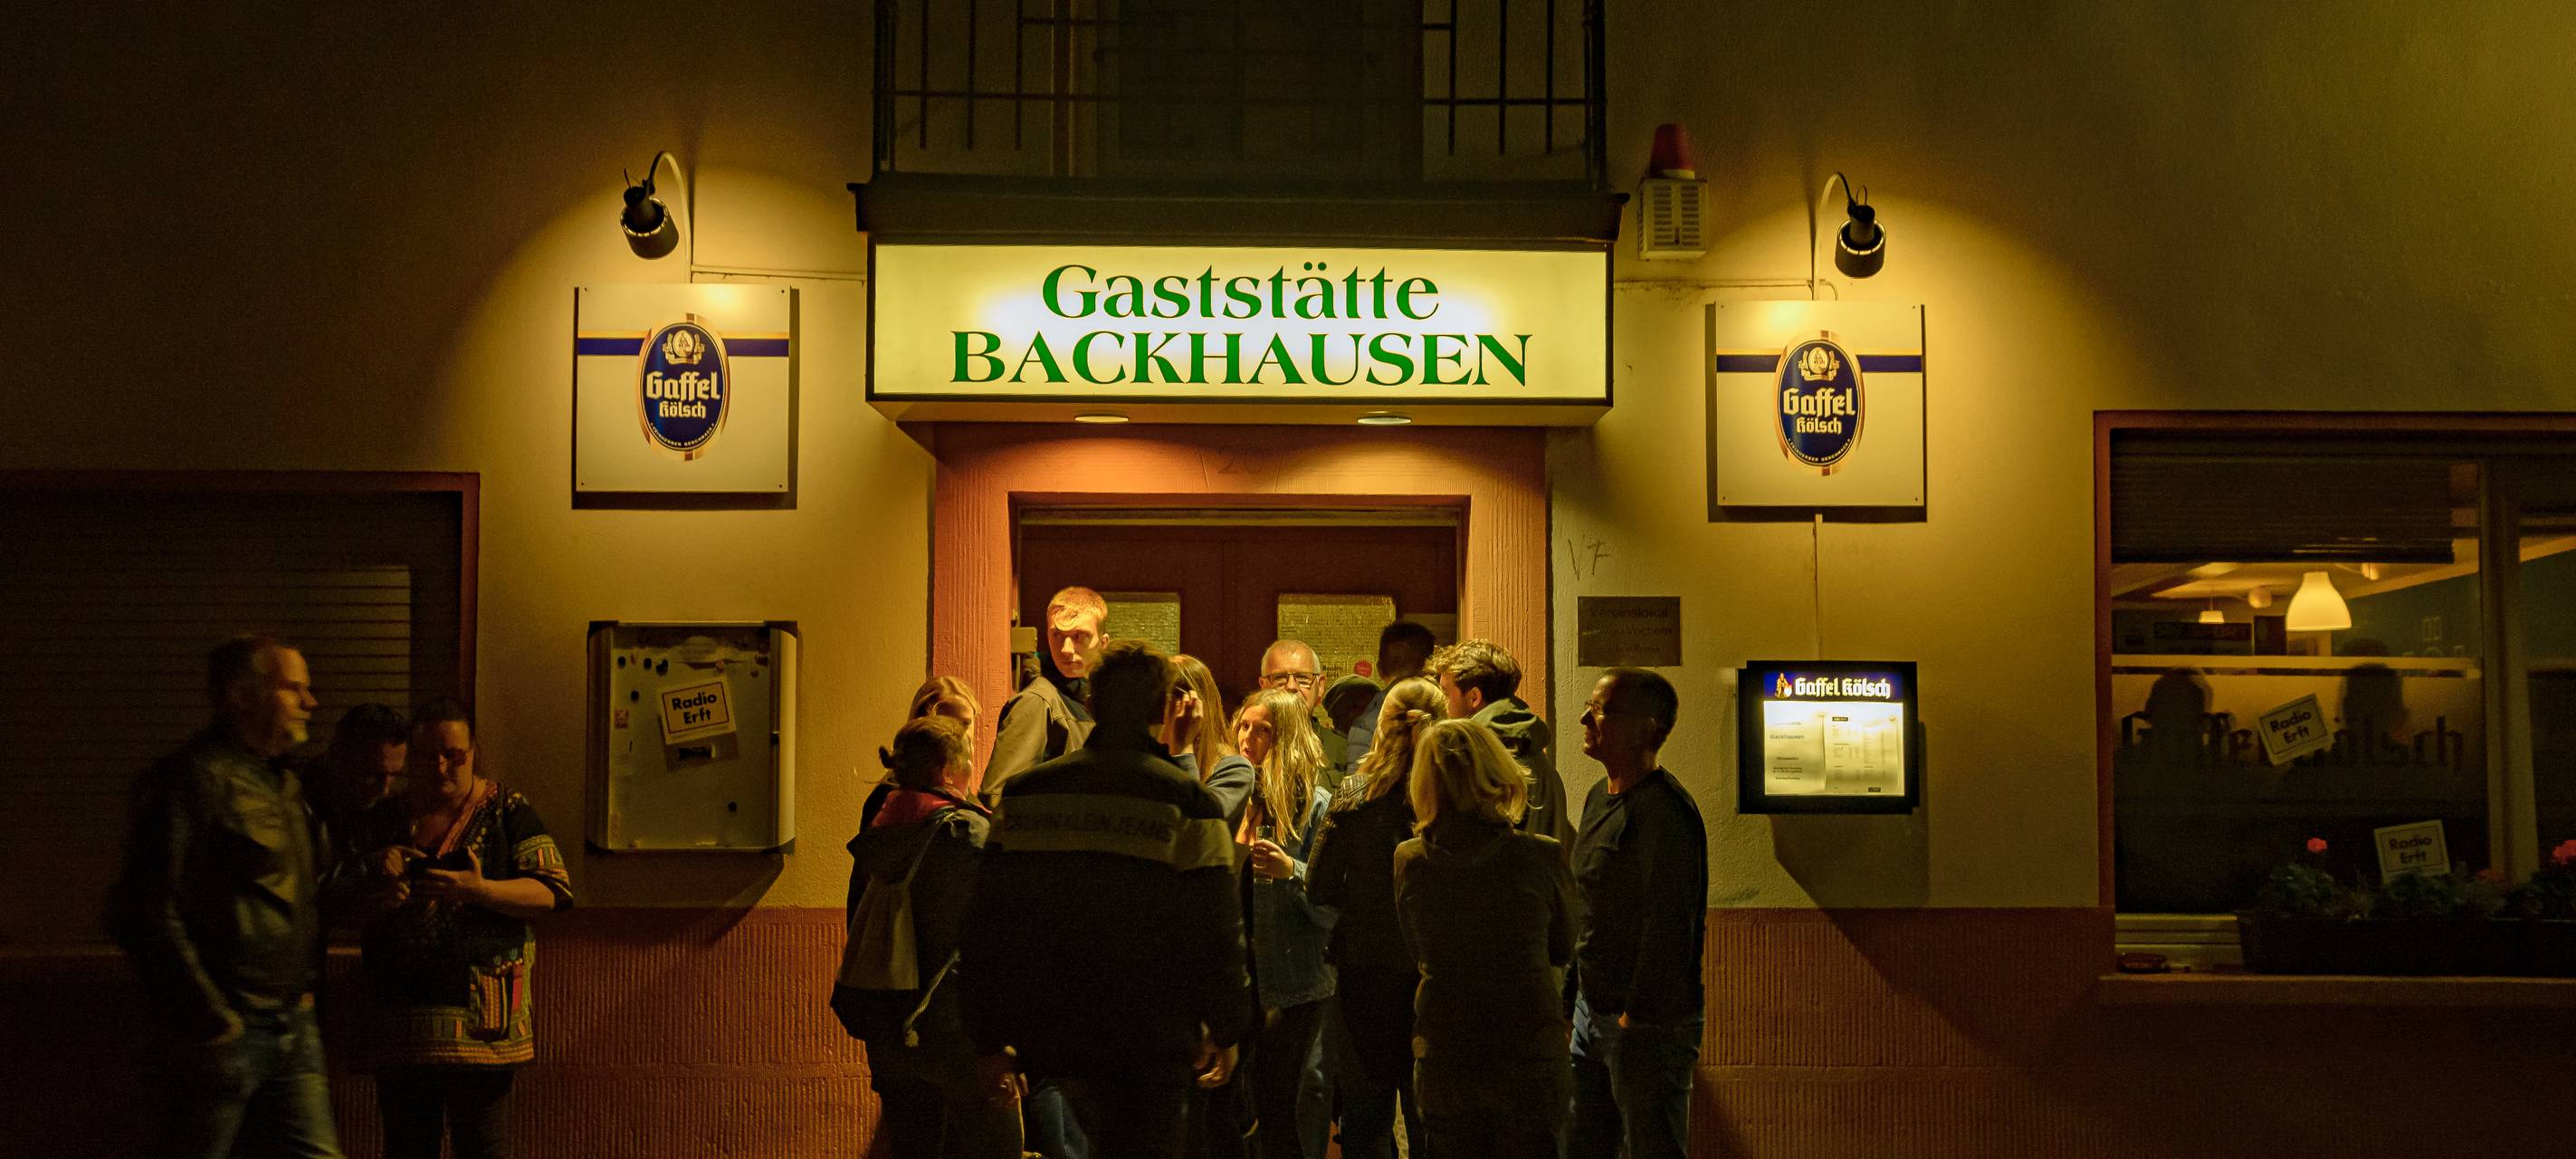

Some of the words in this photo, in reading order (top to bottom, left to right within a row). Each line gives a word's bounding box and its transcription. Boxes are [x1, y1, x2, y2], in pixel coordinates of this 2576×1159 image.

[1042, 262, 1440, 320] Gaststätte
[949, 330, 1534, 388] BACKHAUSEN
[646, 370, 720, 402] Gaffel
[659, 400, 706, 419] Kölsch
[1783, 387, 1856, 417] Gaffel
[1796, 416, 1842, 435] Kölsch
[1795, 676, 1841, 697] Gaffel
[1842, 677, 1891, 699] Kölsch
[672, 691, 717, 711] Radio
[683, 707, 711, 724] Erft
[2269, 711, 2312, 733] Radio
[2284, 725, 2310, 743] Erft
[2390, 835, 2432, 849] Radio
[2399, 850, 2427, 864] Erft
